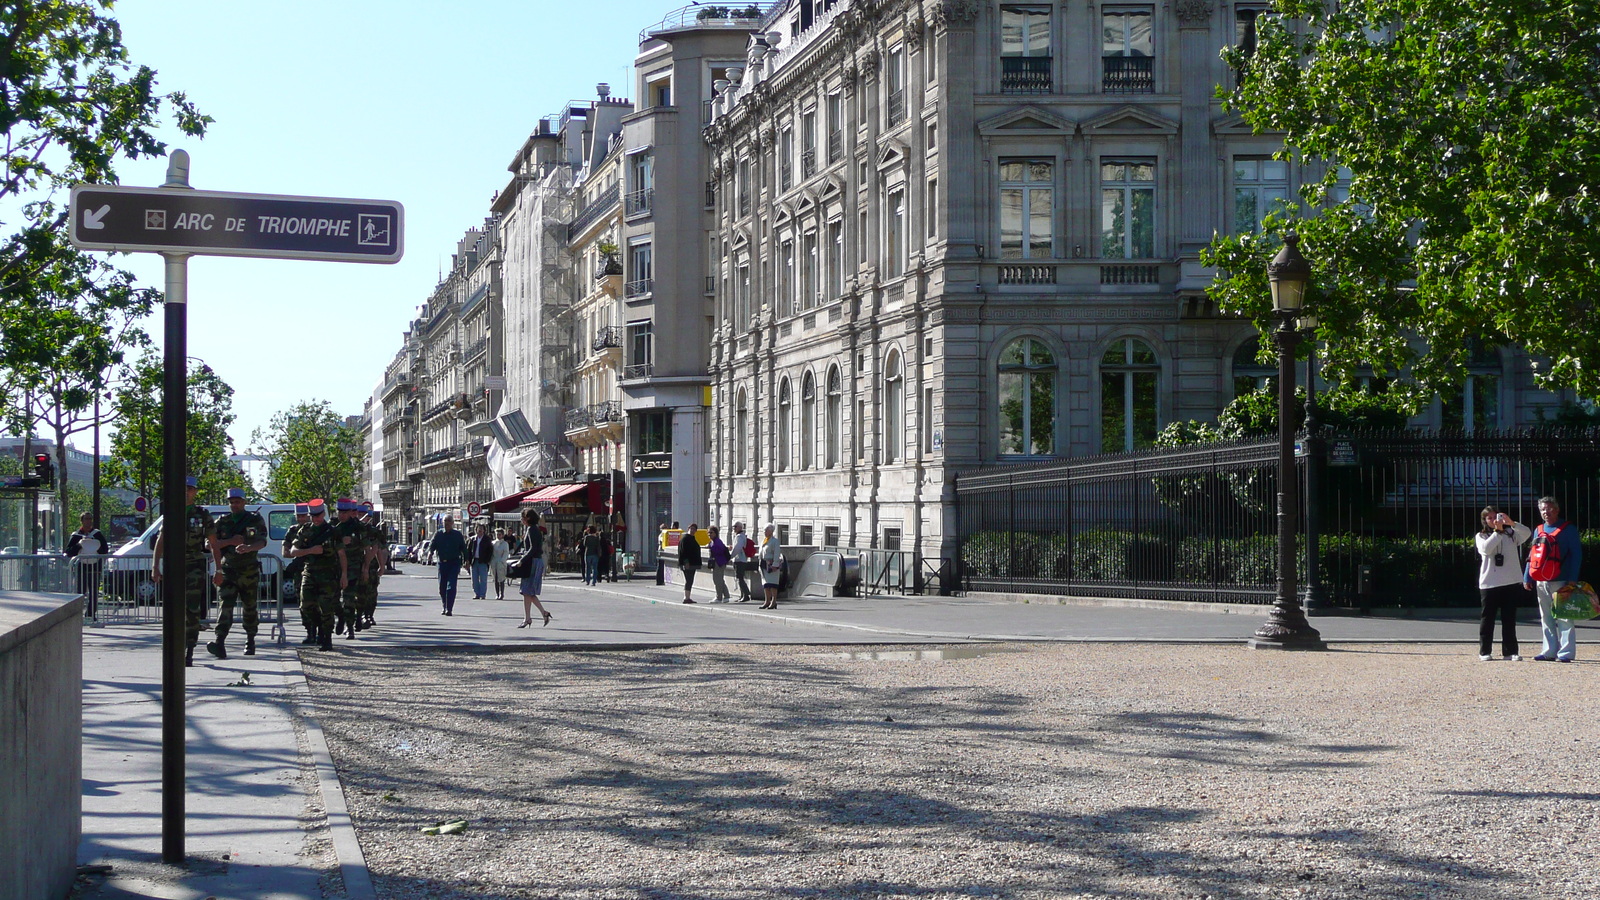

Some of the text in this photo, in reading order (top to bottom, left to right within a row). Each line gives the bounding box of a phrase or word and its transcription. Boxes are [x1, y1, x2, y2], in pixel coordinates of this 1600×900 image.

[173, 212, 352, 237] ARC DE TRIOMPHE
[641, 460, 670, 469] LEXUS
[470, 505, 479, 513] 30
